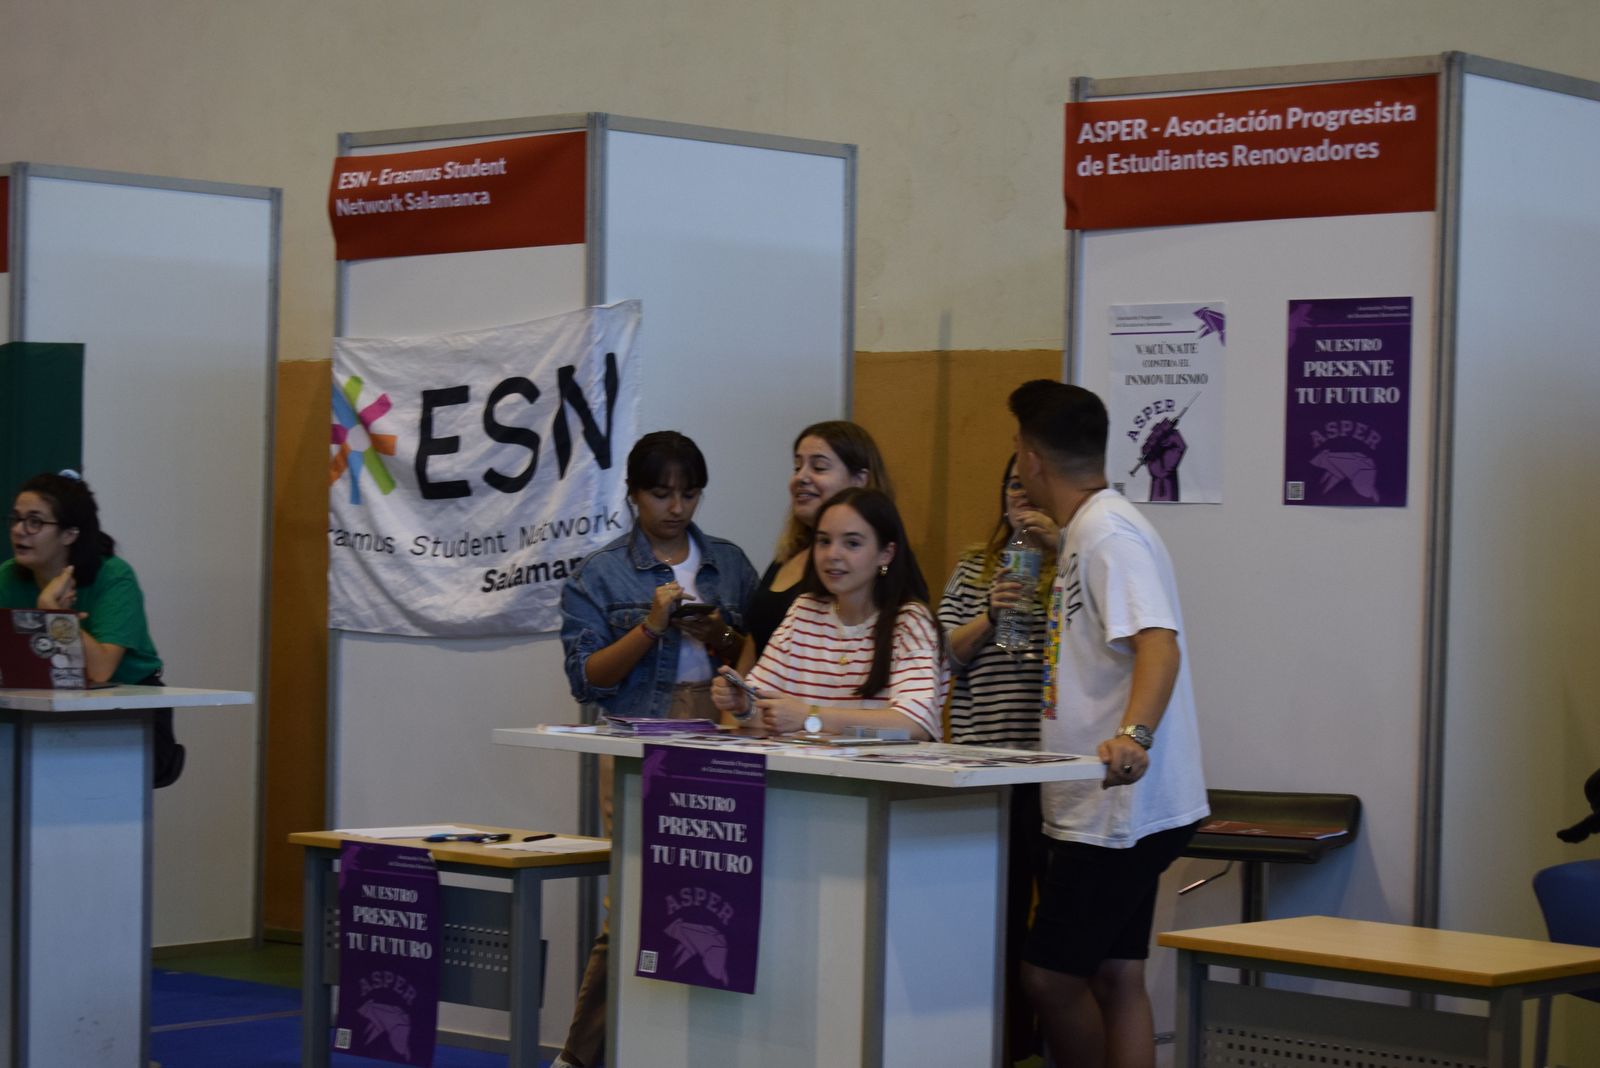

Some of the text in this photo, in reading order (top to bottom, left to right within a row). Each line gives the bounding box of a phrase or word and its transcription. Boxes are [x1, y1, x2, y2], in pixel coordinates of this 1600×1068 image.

[1078, 118, 1148, 144] ASPER
[1164, 110, 1282, 138] Asociación
[1286, 101, 1416, 131] Progresista
[1077, 139, 1379, 177] de Estudiantes Renovadores
[337, 170, 371, 190] ESN
[378, 167, 441, 186] Erasmus
[443, 157, 507, 180] Student
[336, 190, 491, 217] Network Salamanca
[1315, 338, 1383, 352] NUESTRO
[1303, 359, 1394, 377] PRESENTE
[1295, 386, 1401, 404] TU FUTURO
[415, 352, 620, 500] ESN
[1127, 399, 1176, 443] ASPER
[1310, 420, 1382, 450] ASPER
[409, 531, 508, 558] Student
[669, 791, 736, 812] NUESTRO
[658, 815, 747, 843] PRESENTE
[650, 844, 753, 875] TU FUTURO
[361, 884, 418, 903] NUESTRO
[665, 887, 735, 925] ASPER
[352, 905, 428, 931] PRESENTE
[346, 931, 433, 960] TU FUTURO
[359, 970, 417, 1006] ASPER
